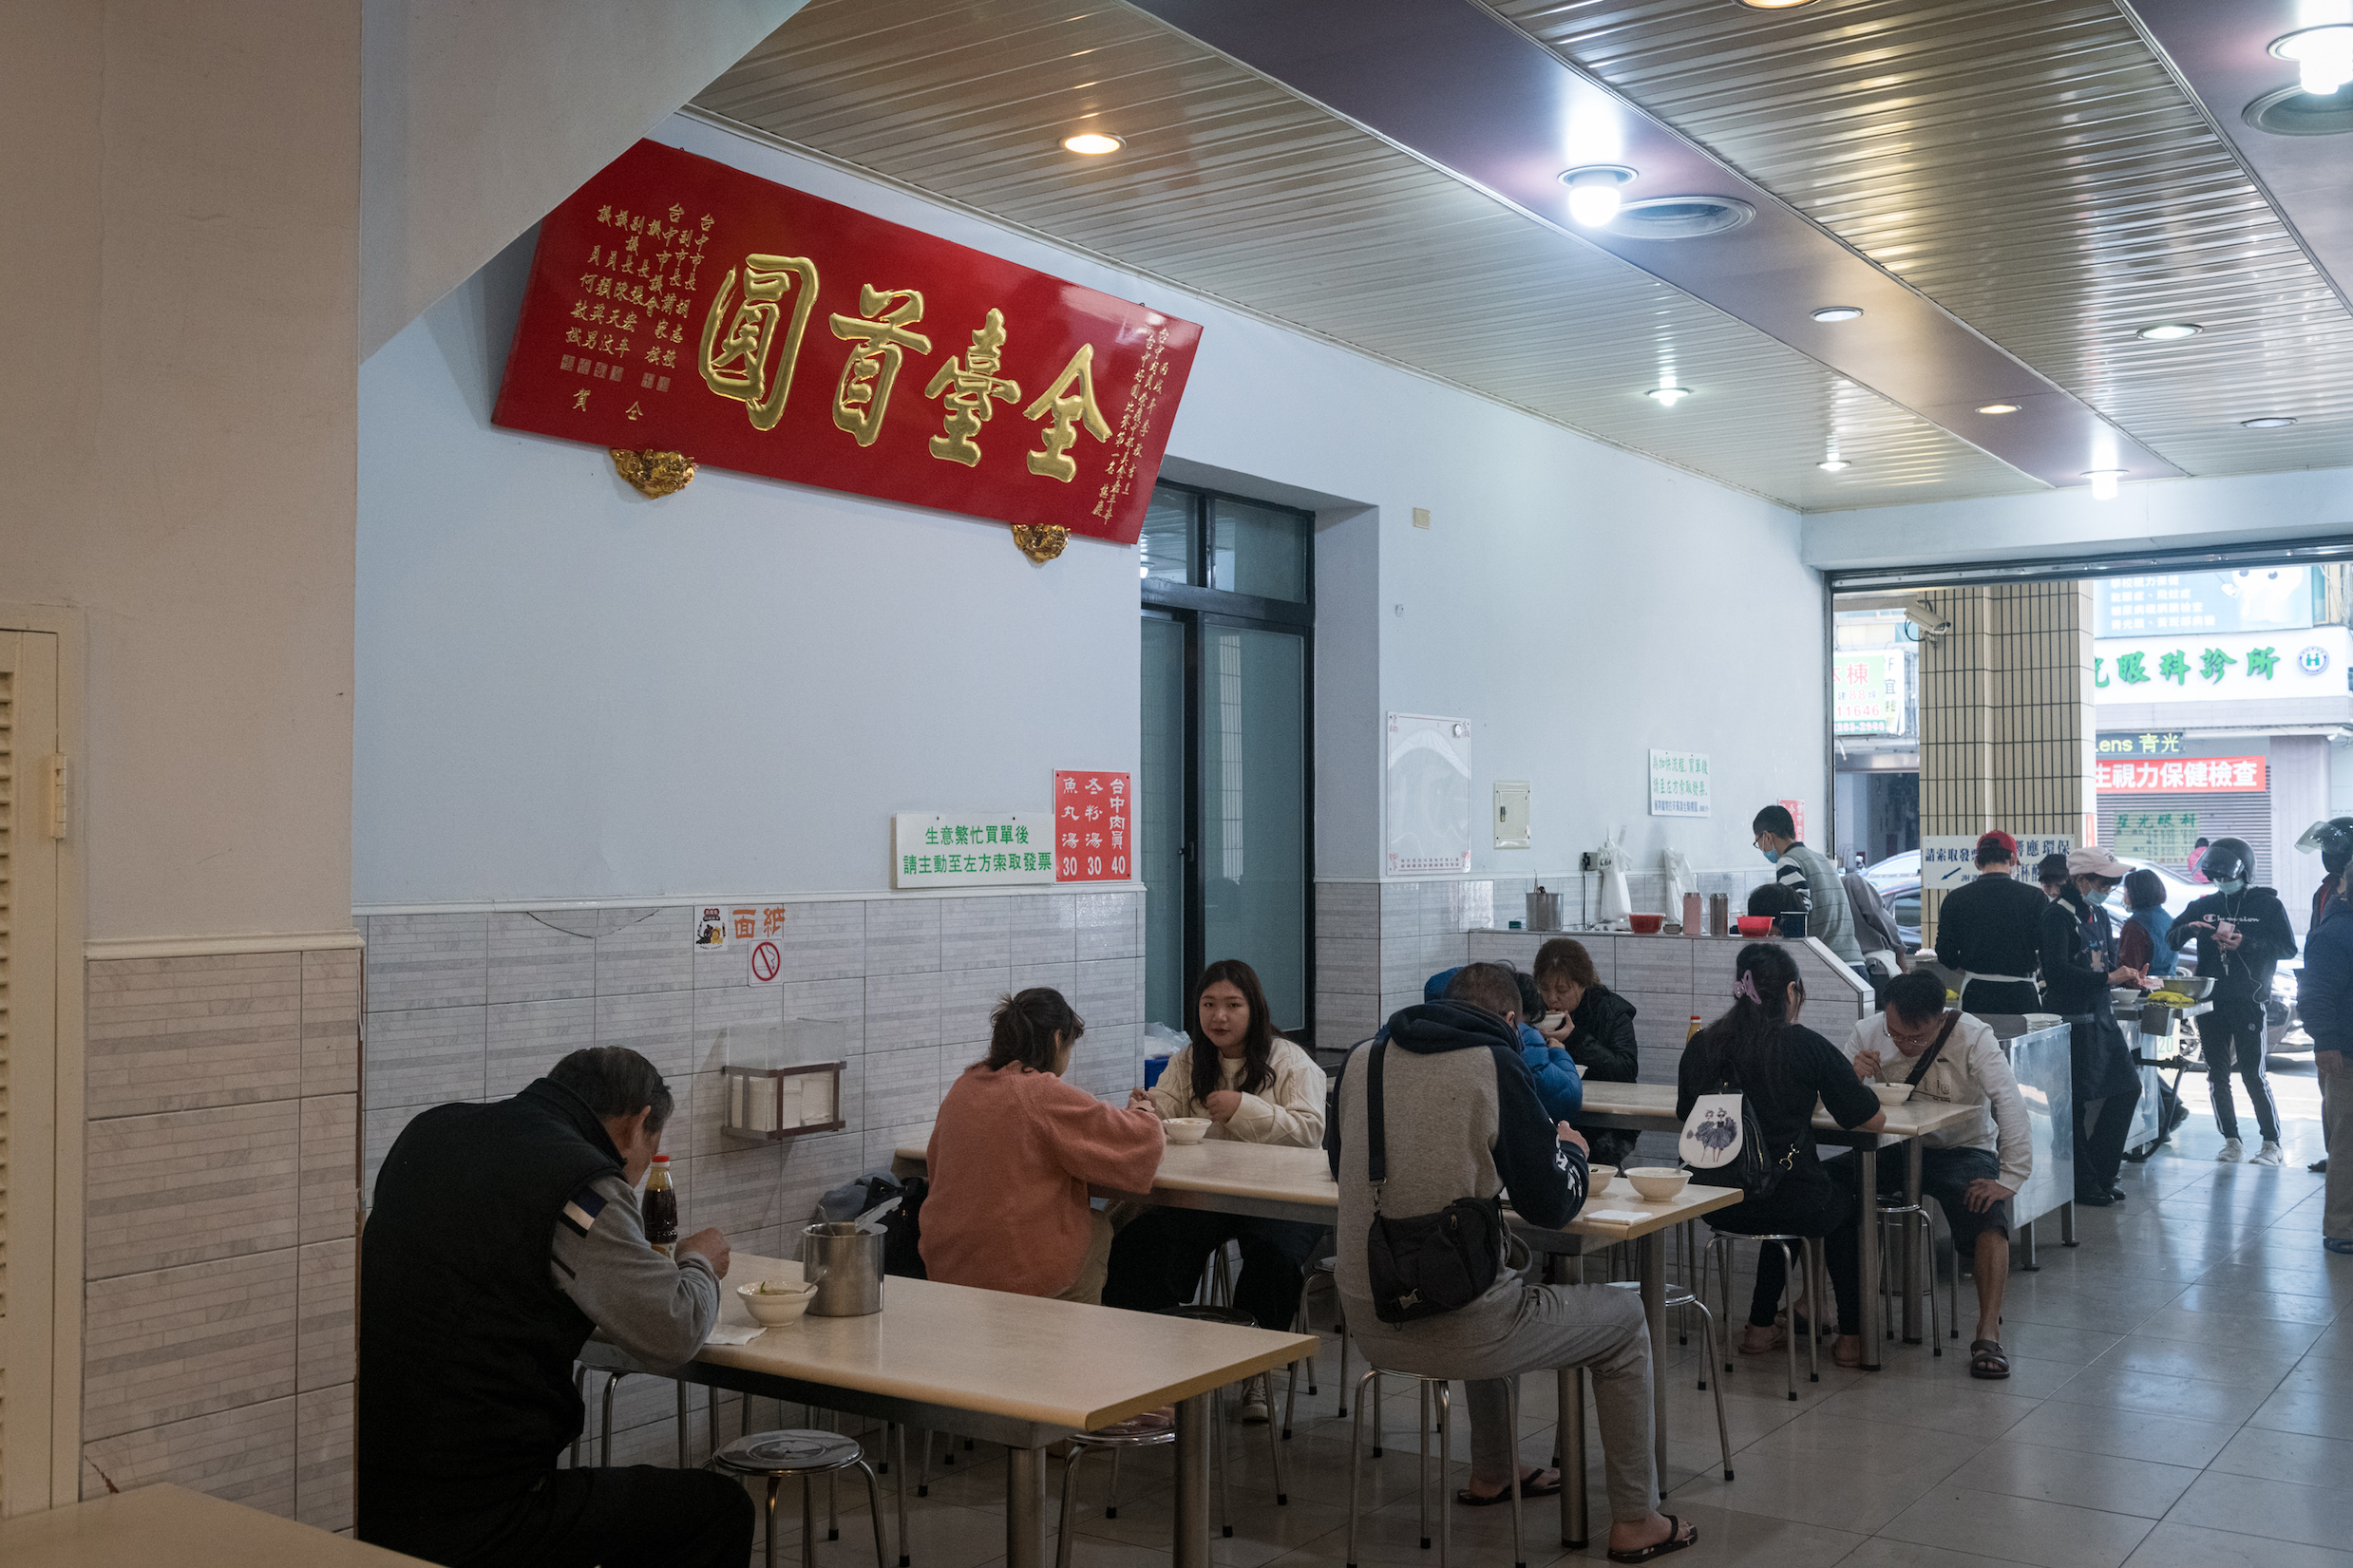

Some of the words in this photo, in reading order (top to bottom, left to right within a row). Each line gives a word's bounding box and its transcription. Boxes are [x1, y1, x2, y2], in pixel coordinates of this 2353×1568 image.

[2096, 738, 2134, 753] ens
[2138, 732, 2179, 753] 青光
[924, 823, 1031, 846] 生意繁忙買單後
[902, 851, 1053, 876] 請主動至左方索取發票
[1062, 857, 1078, 877] 30
[1087, 856, 1102, 876] 30
[1110, 856, 1127, 875] 40
[732, 907, 786, 939] 面紙
